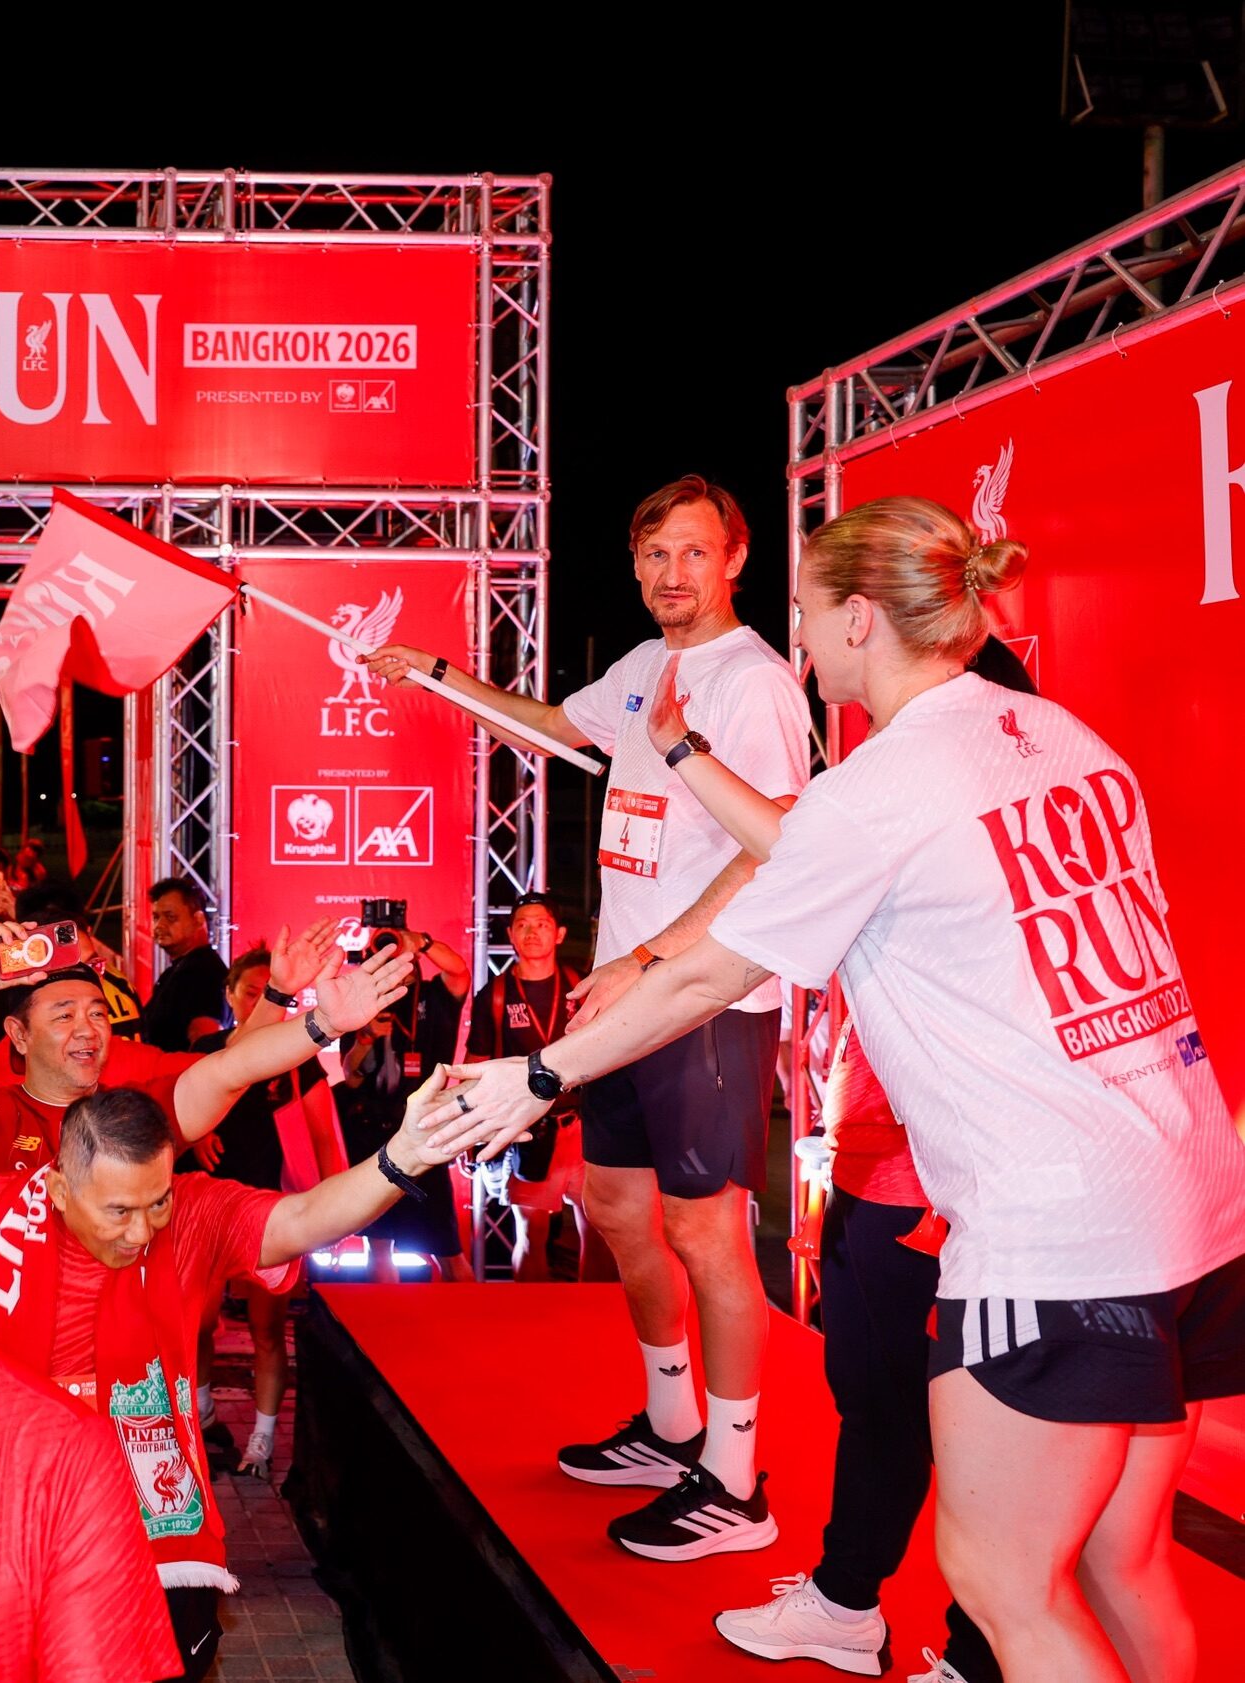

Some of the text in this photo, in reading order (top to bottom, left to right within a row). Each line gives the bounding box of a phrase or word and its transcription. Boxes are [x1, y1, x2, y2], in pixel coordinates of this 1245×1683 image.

[191, 330, 411, 363] BANGKOK 2026
[196, 390, 323, 404] PRESENTED BY
[319, 707, 396, 737] L.F.C.
[317, 769, 390, 779] PRESENTED BY
[284, 826, 419, 857] Krungthai AXA
[619, 816, 630, 852] 4
[977, 768, 1137, 914] KOP
[1014, 869, 1174, 1019] RUN
[1063, 985, 1192, 1056] BANGKOK 202
[127, 1427, 175, 1442] LIVERP
[130, 1440, 173, 1454] FOOTBALL
